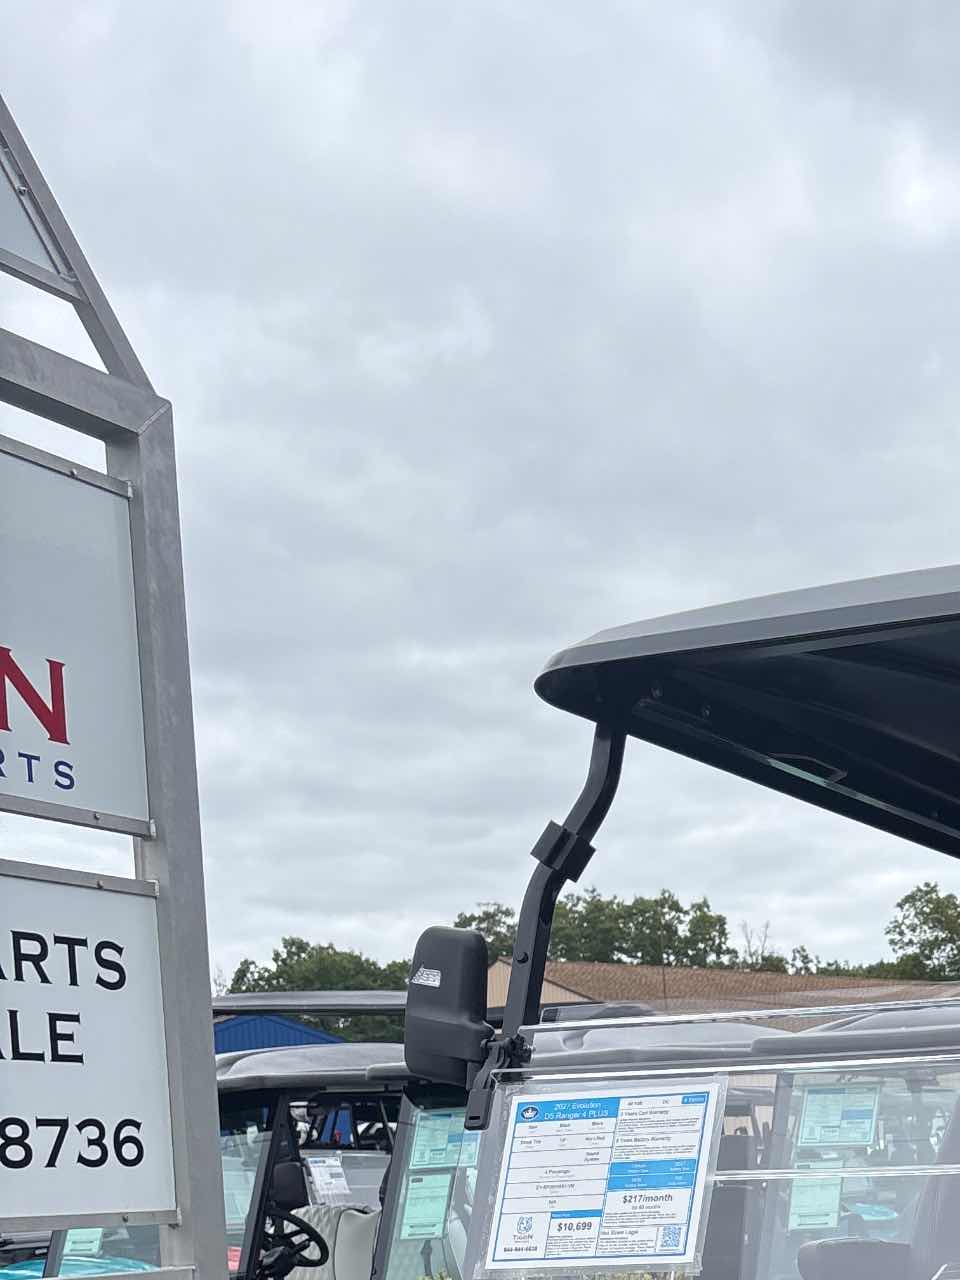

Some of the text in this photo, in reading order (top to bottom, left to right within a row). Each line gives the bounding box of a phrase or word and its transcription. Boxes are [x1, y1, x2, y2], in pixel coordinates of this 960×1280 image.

[0, 646, 70, 745] N
[0, 749, 75, 790] TS
[0, 929, 126, 991] RTS
[0, 1009, 84, 1065] LE
[0, 1116, 144, 1169] 8736
[557, 1221, 593, 1232] $10,699
